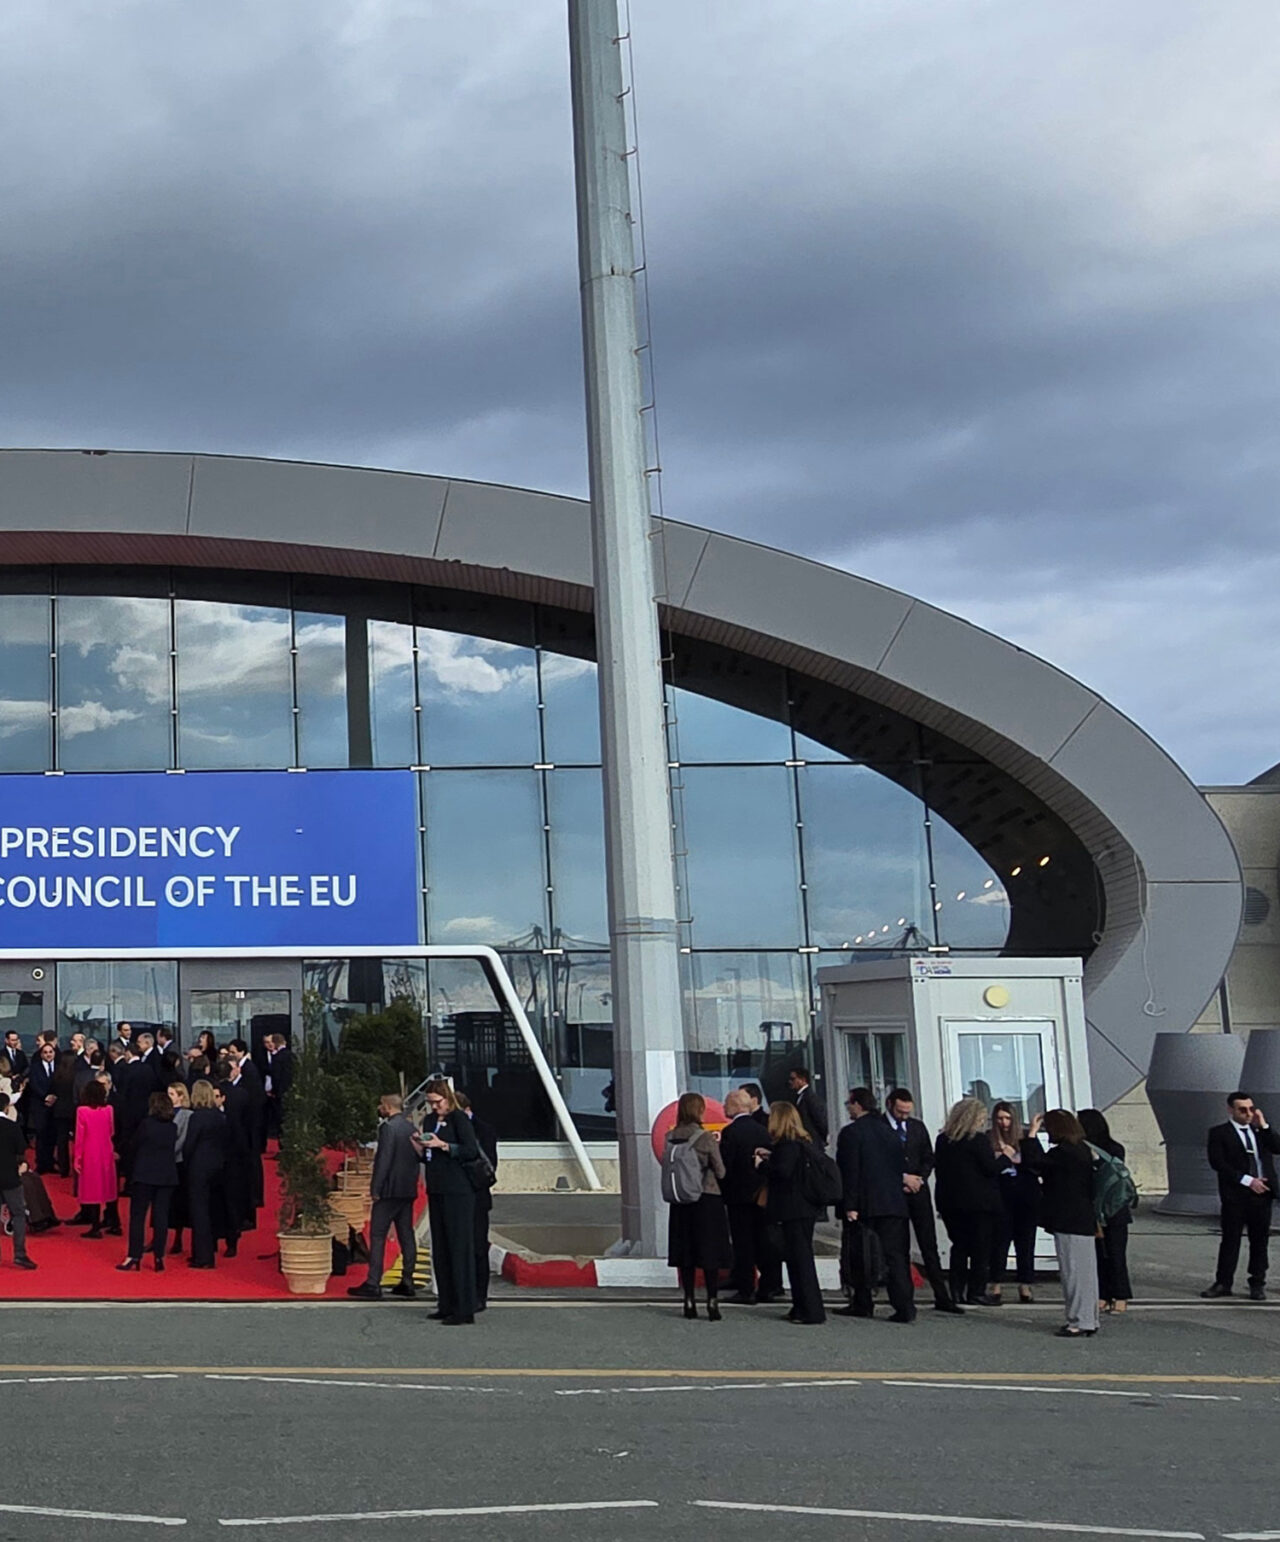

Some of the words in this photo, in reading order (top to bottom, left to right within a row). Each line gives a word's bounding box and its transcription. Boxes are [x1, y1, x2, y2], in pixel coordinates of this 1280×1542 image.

[2, 827, 240, 858] PRESIDENCY
[165, 876, 216, 908] OF
[225, 876, 300, 907] THE
[311, 875, 357, 907] EU
